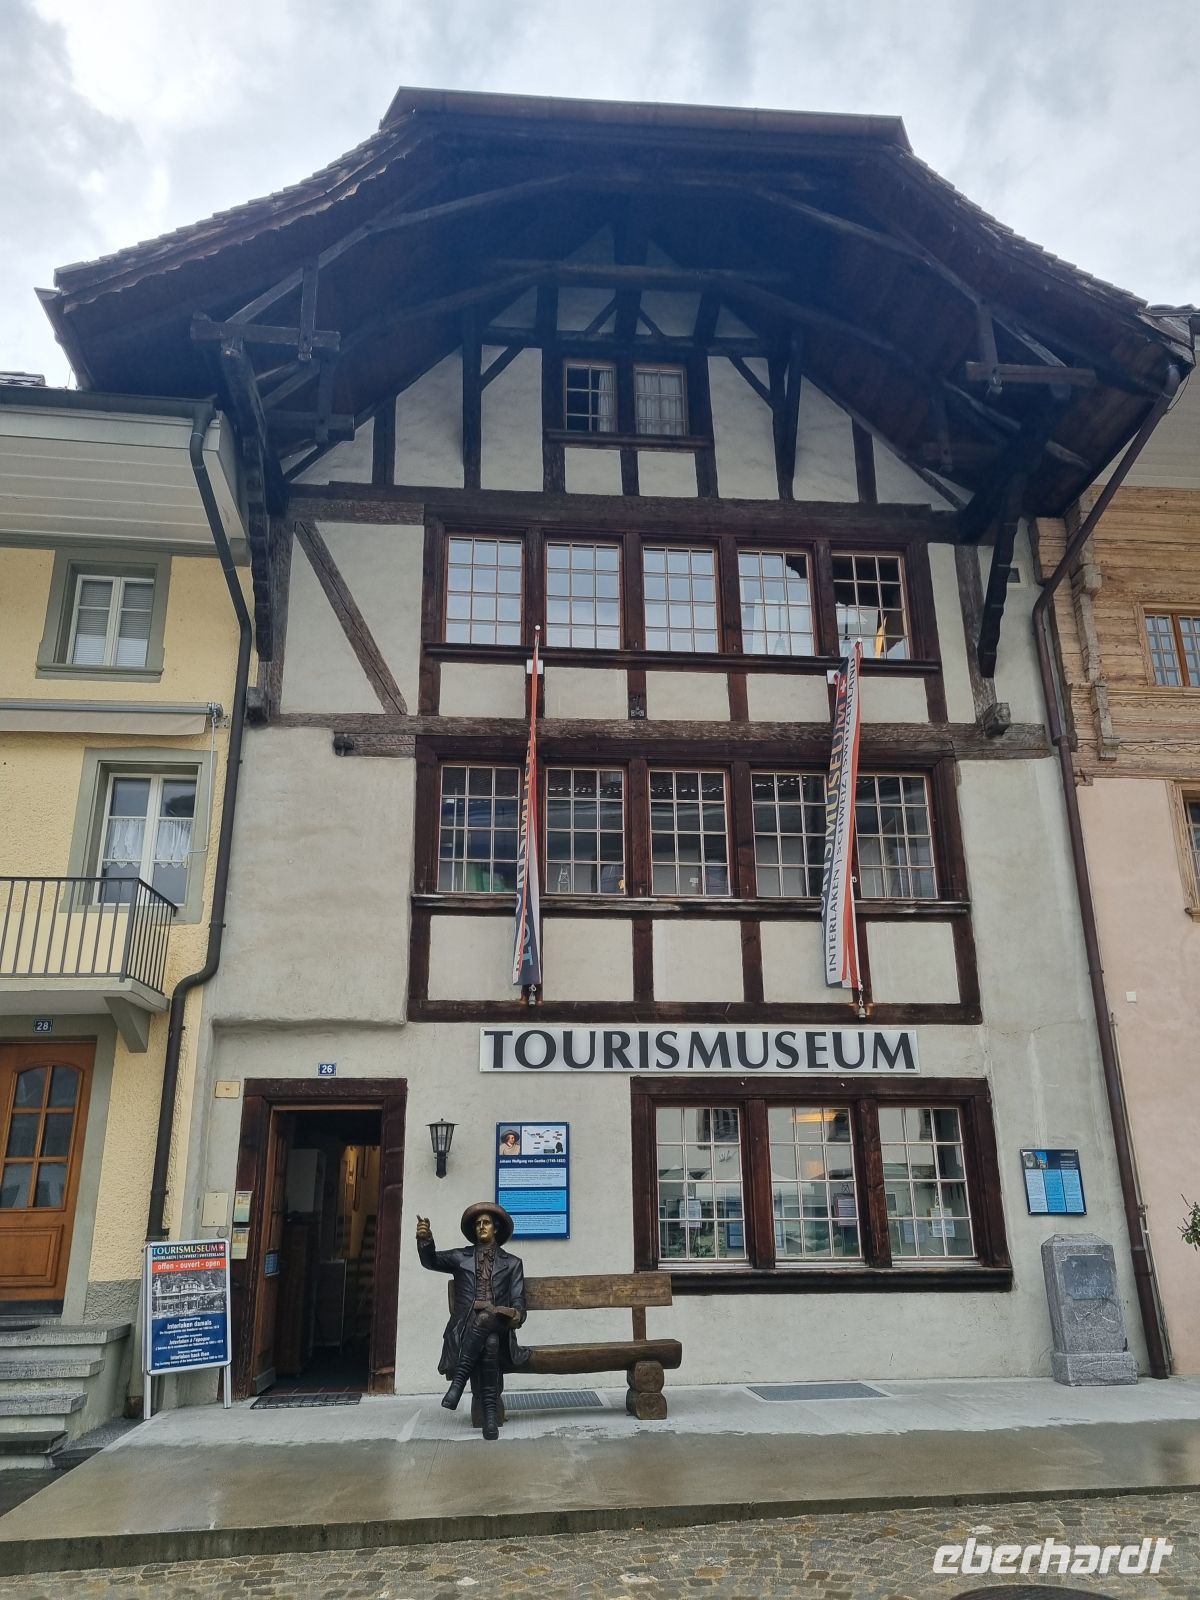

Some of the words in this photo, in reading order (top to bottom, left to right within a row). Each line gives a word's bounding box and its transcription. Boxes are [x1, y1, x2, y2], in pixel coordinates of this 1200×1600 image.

[828, 869, 840, 972] INTERLAKEN
[836, 780, 848, 856] SCHWEIZ
[842, 658, 856, 767] SWITZERLAND
[36, 1021, 49, 1031] 28
[484, 1030, 916, 1070] TOURISMUSEUM
[321, 1064, 333, 1074] 26
[152, 1244, 218, 1255] TOURISMUSEUM
[157, 1262, 174, 1270] offen
[180, 1261, 200, 1269] ouvert
[205, 1260, 220, 1269] open
[167, 1321, 193, 1330] Interlaken
